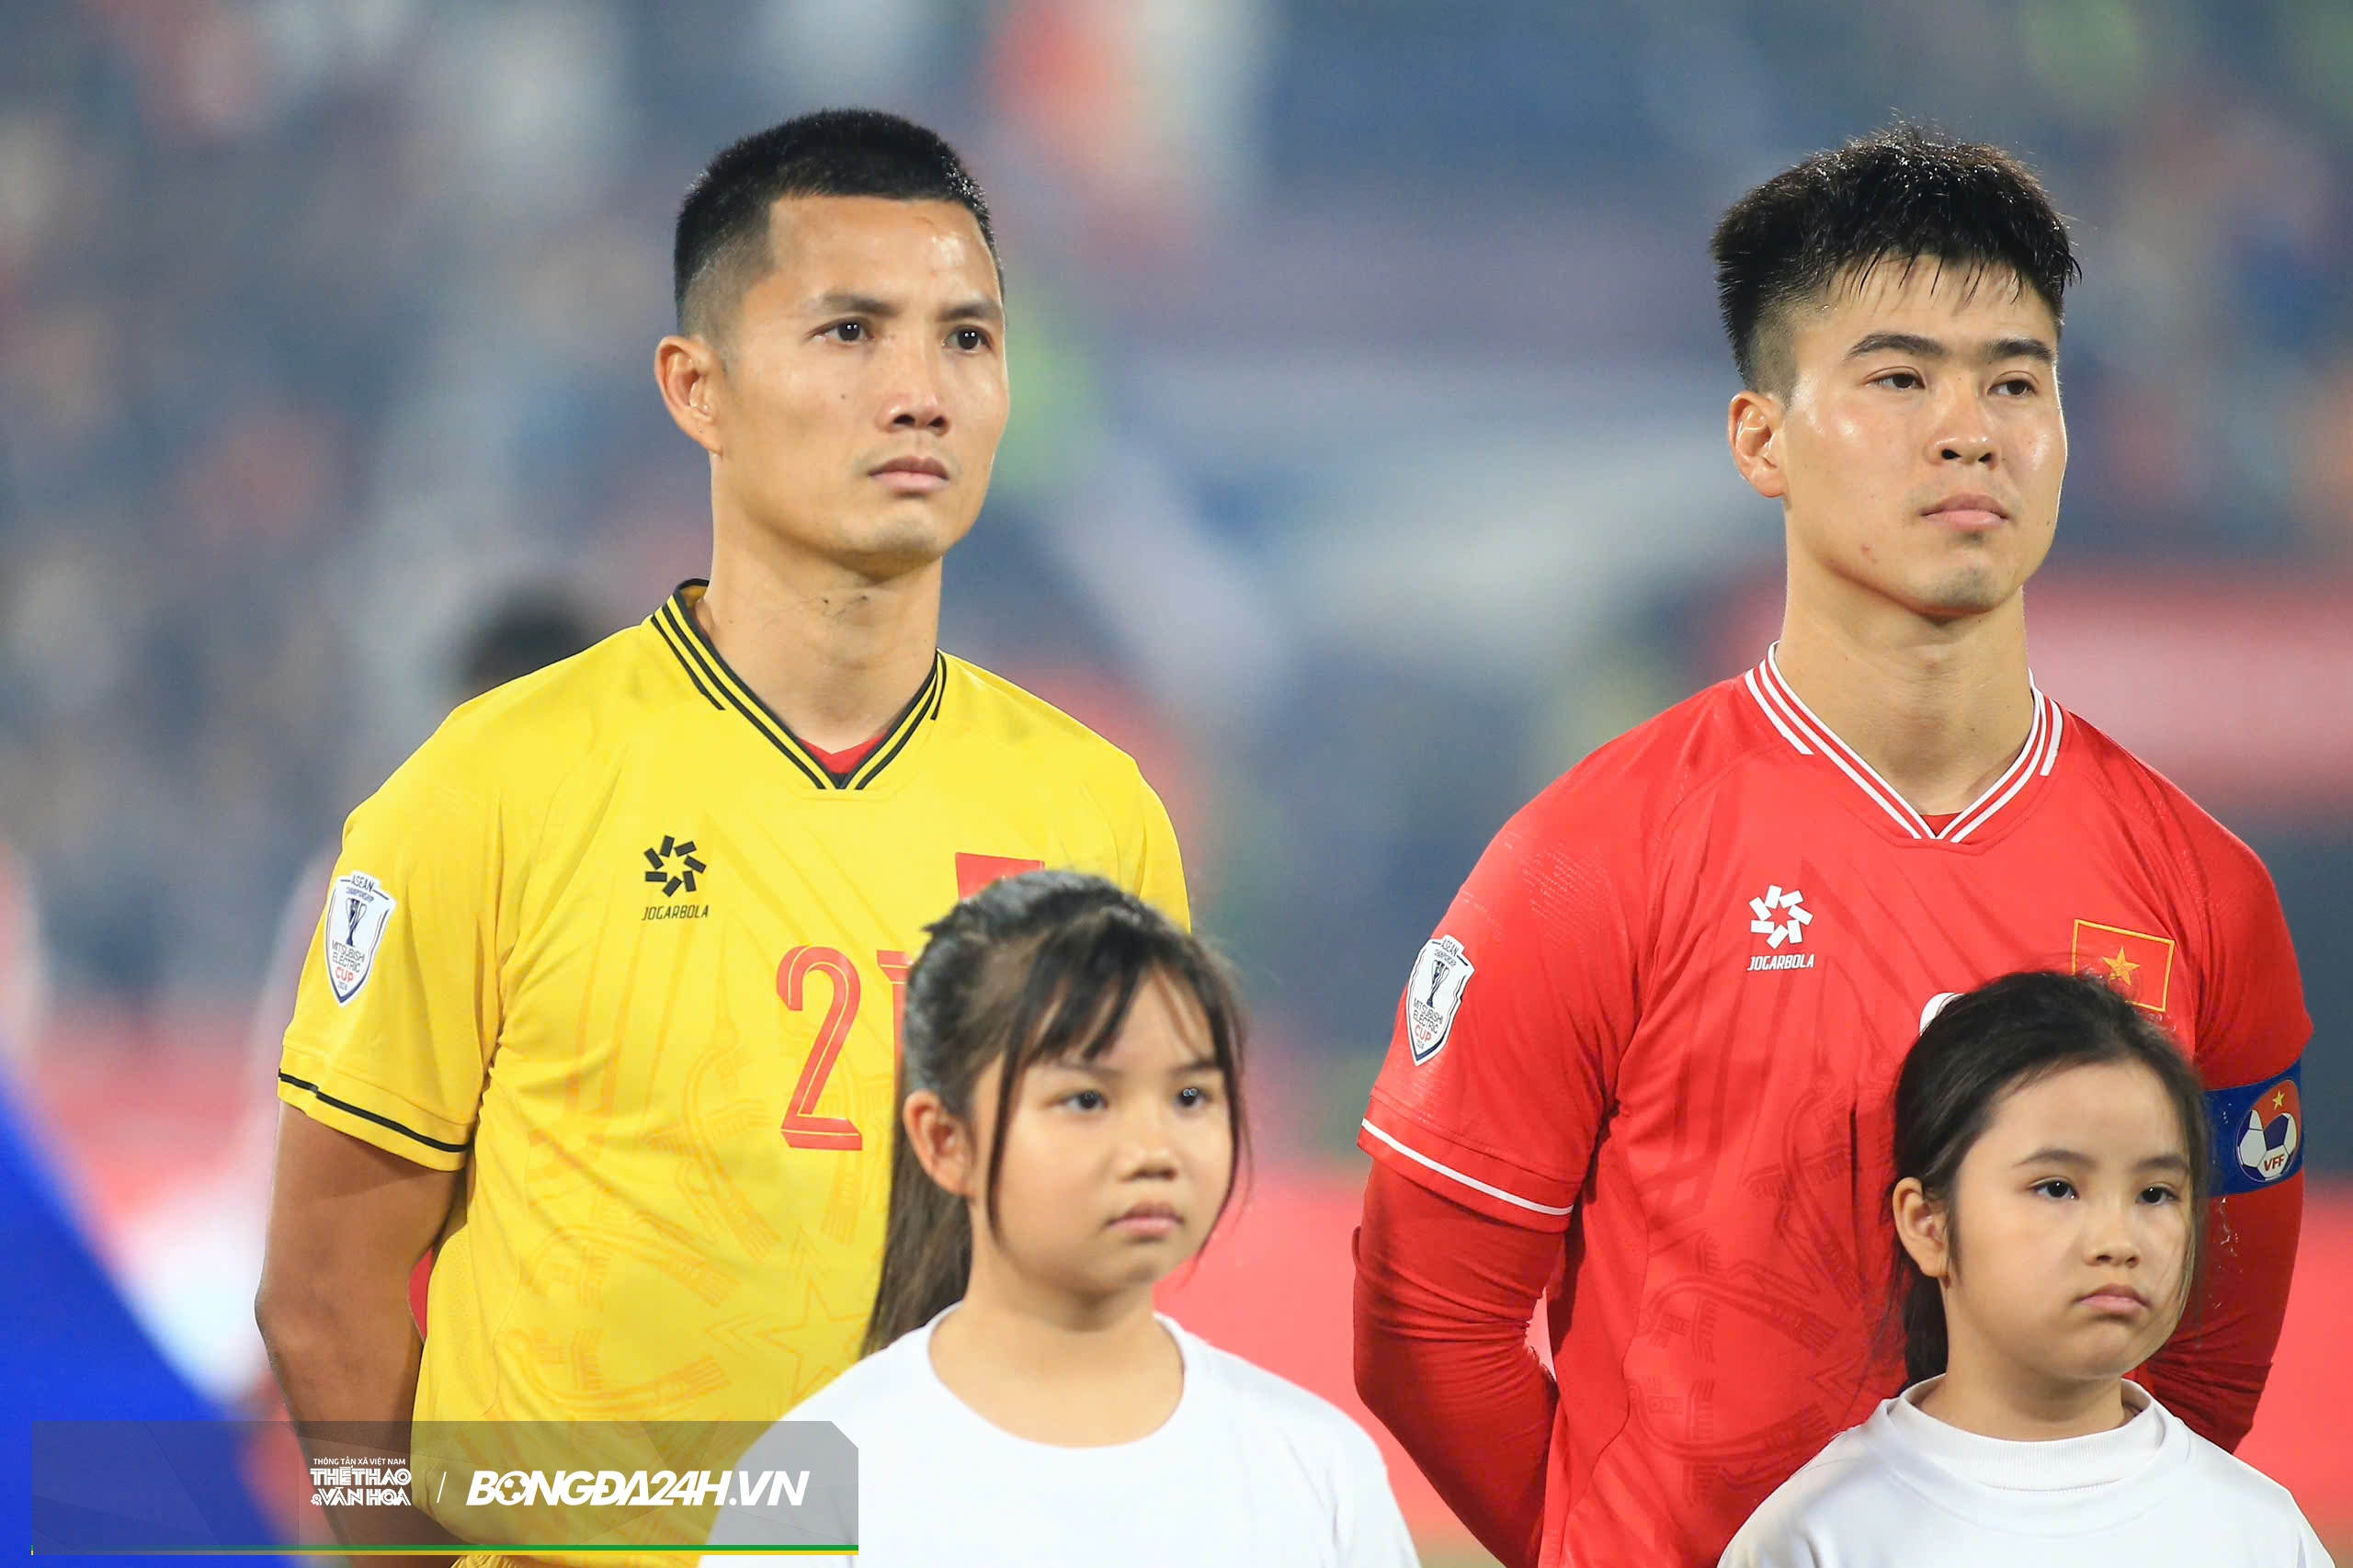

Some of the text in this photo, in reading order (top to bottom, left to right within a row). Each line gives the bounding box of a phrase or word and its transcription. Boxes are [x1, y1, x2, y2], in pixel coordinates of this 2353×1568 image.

[351, 875, 374, 892] ASEAN
[641, 904, 709, 921] JOGARBOLA
[332, 939, 365, 963] MITSUBISHI
[1440, 938, 1460, 958] ASEAN
[332, 951, 361, 972] ELECTRIC
[1746, 953, 1815, 971] JOGARBOLA
[335, 966, 354, 983] CUP
[1413, 997, 1443, 1025] MITSUBISHI
[1413, 1009, 1438, 1034] ELECTRIC
[1415, 1024, 1432, 1042] CUP
[2264, 1153, 2285, 1172] VFF
